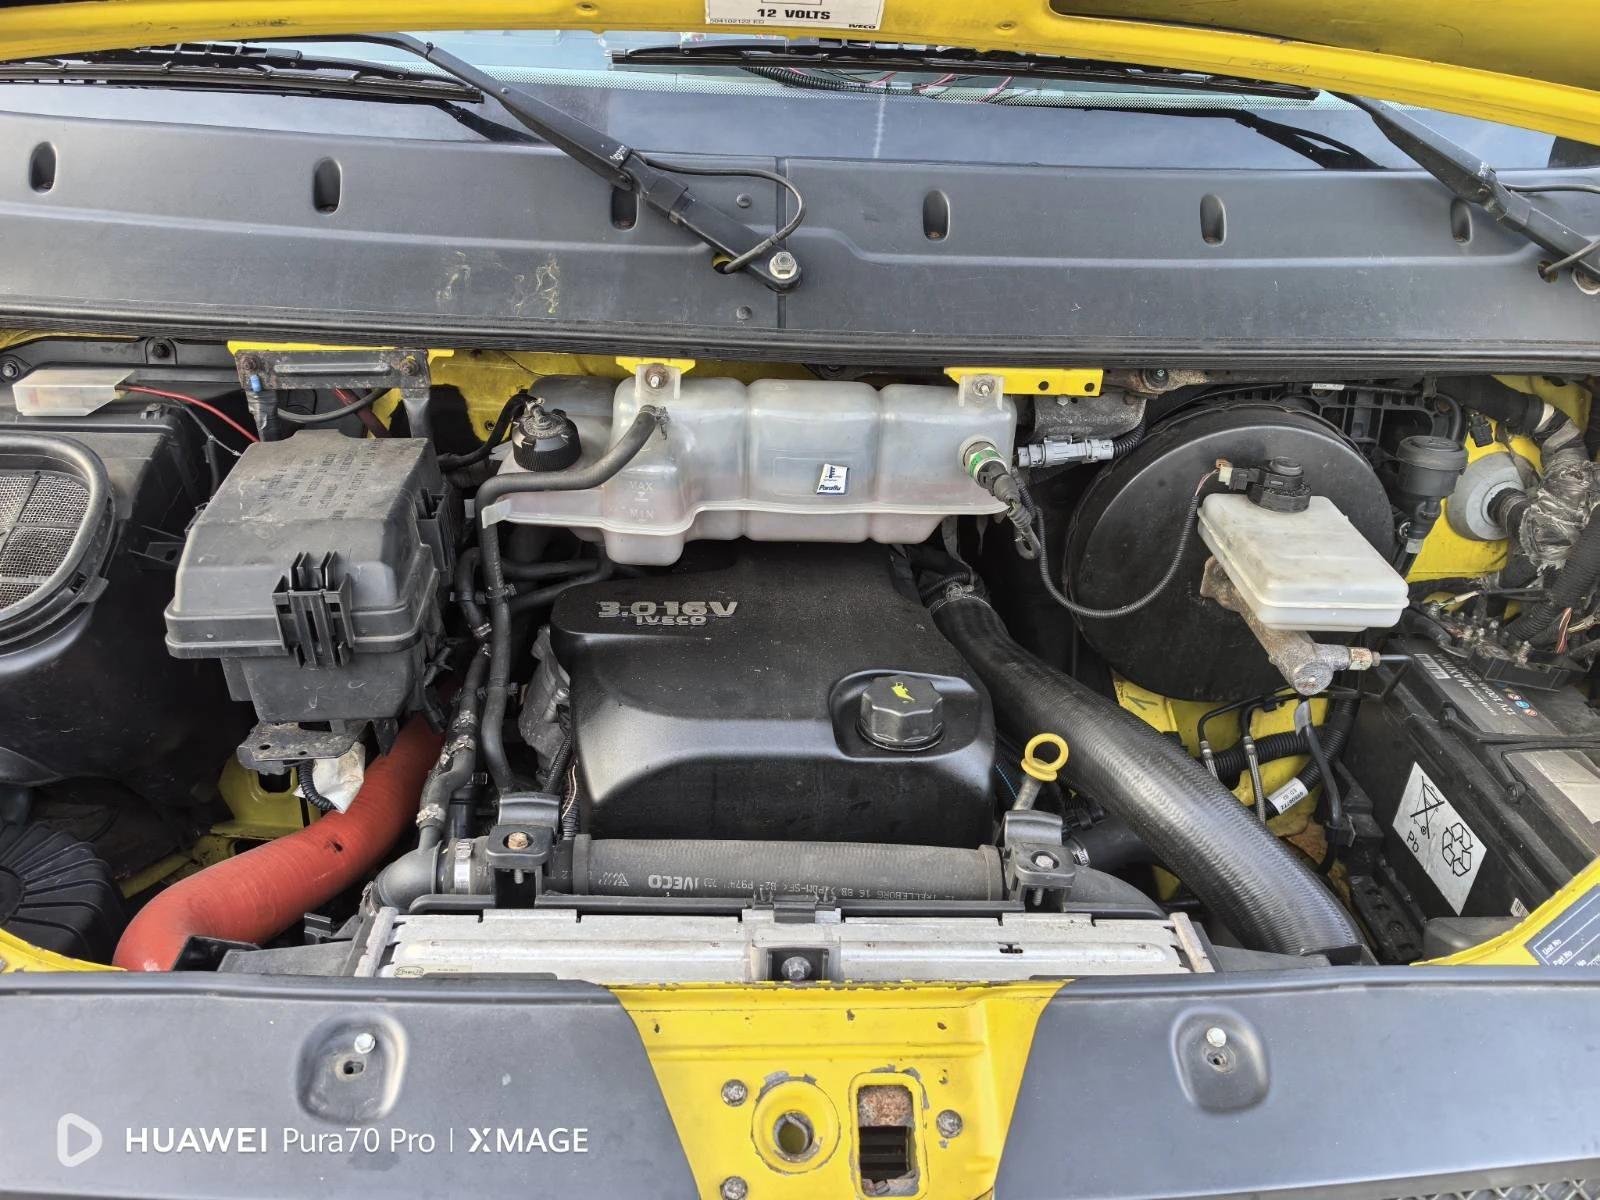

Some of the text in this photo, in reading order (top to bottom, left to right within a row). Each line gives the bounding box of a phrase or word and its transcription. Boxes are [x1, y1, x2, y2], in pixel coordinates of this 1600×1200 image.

[757, 8, 831, 20] 12 VOLTS
[635, 614, 708, 626] IVECO
[1406, 829, 1420, 853] Pb
[647, 874, 700, 891] IVECO
